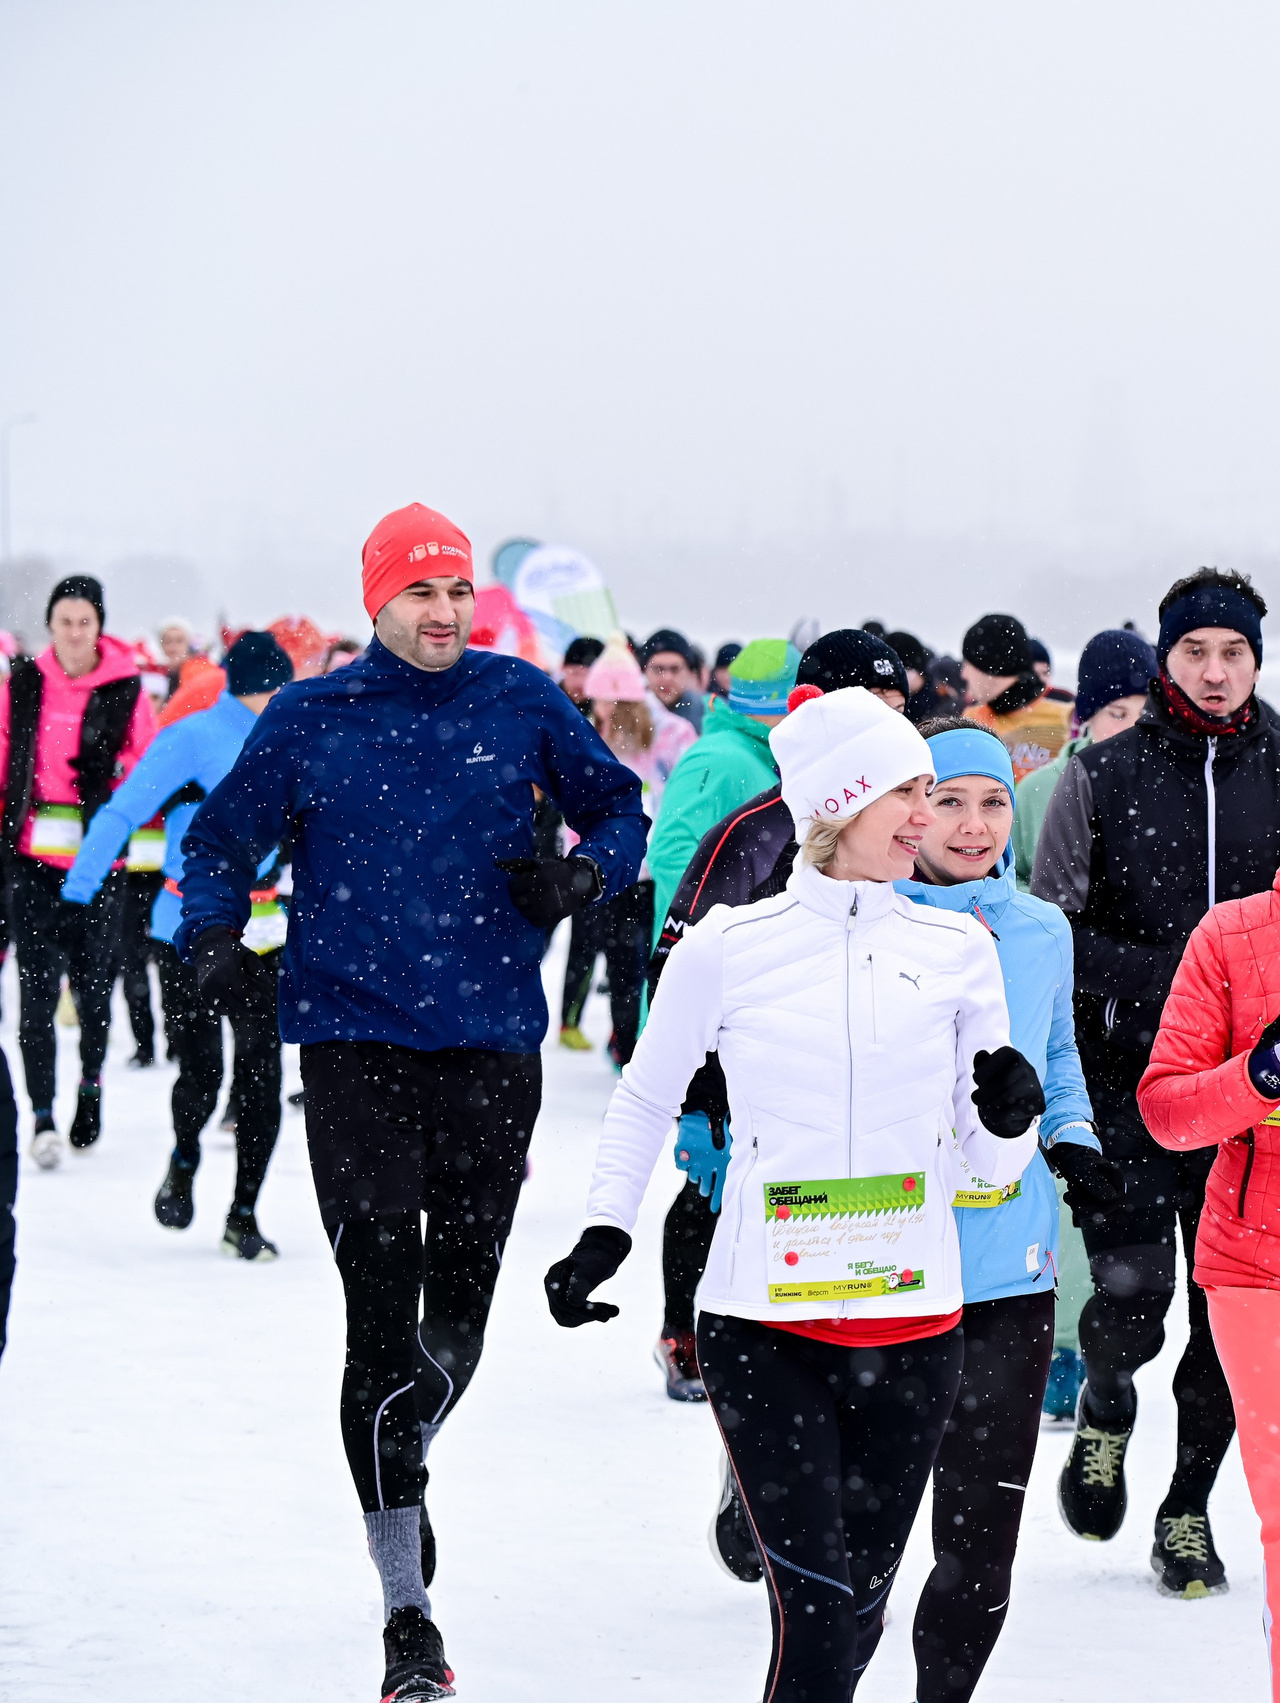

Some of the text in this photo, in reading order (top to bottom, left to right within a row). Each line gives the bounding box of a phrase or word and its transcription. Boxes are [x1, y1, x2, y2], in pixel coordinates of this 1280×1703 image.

[768, 1185, 801, 1196] ЗАБЕГ
[769, 1192, 828, 1207] ОБЕЩАНИЙ
[855, 1261, 874, 1269] БЕГУ
[863, 1265, 897, 1276] ОБЕЩАЮ
